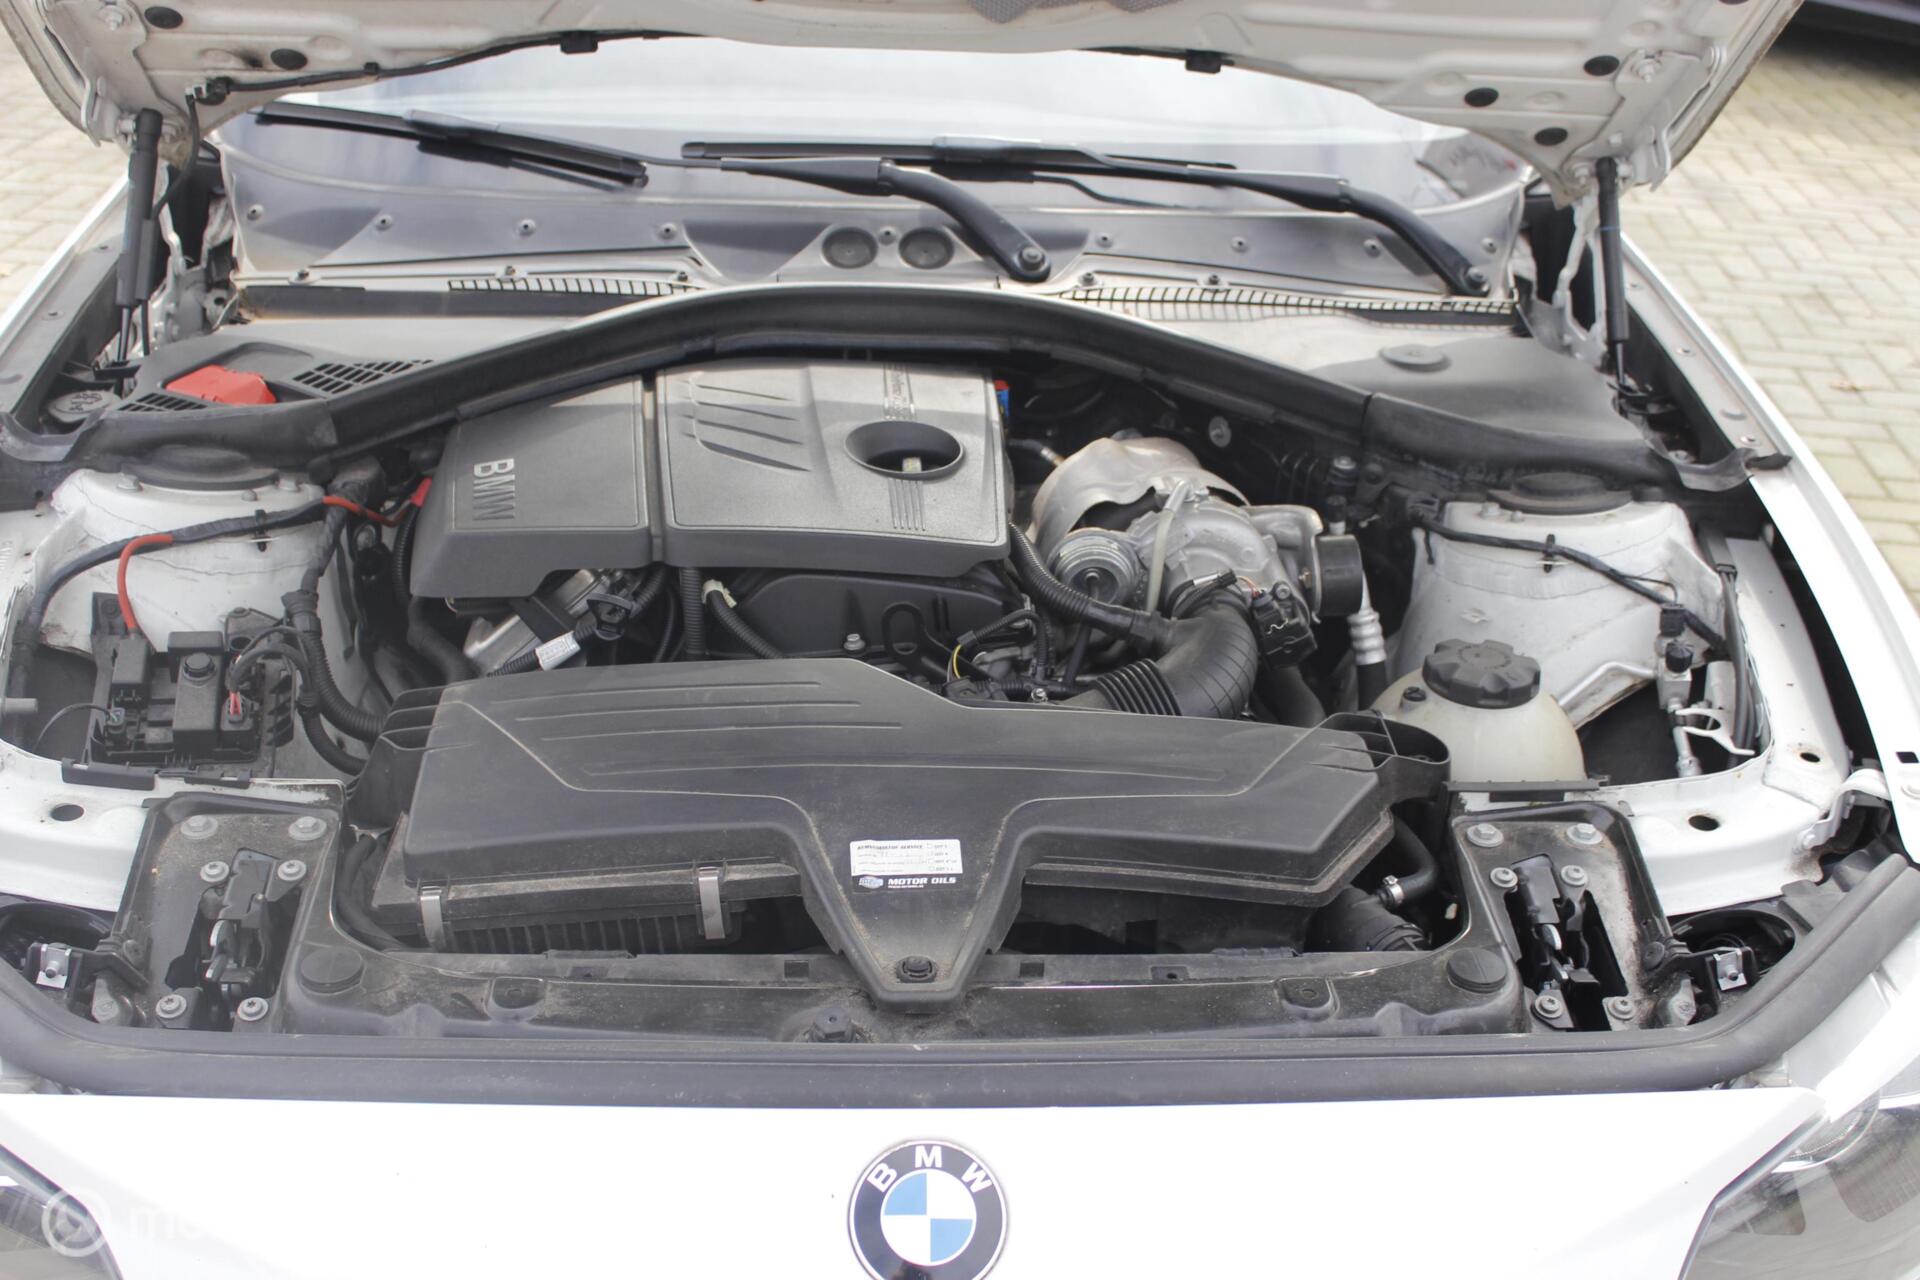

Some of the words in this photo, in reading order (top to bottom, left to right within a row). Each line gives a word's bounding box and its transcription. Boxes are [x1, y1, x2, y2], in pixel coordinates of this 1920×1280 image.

[473, 458, 515, 520] BMW
[887, 877, 928, 885] MOTOR
[931, 876, 957, 884] OILS
[866, 1145, 993, 1193] BMW
